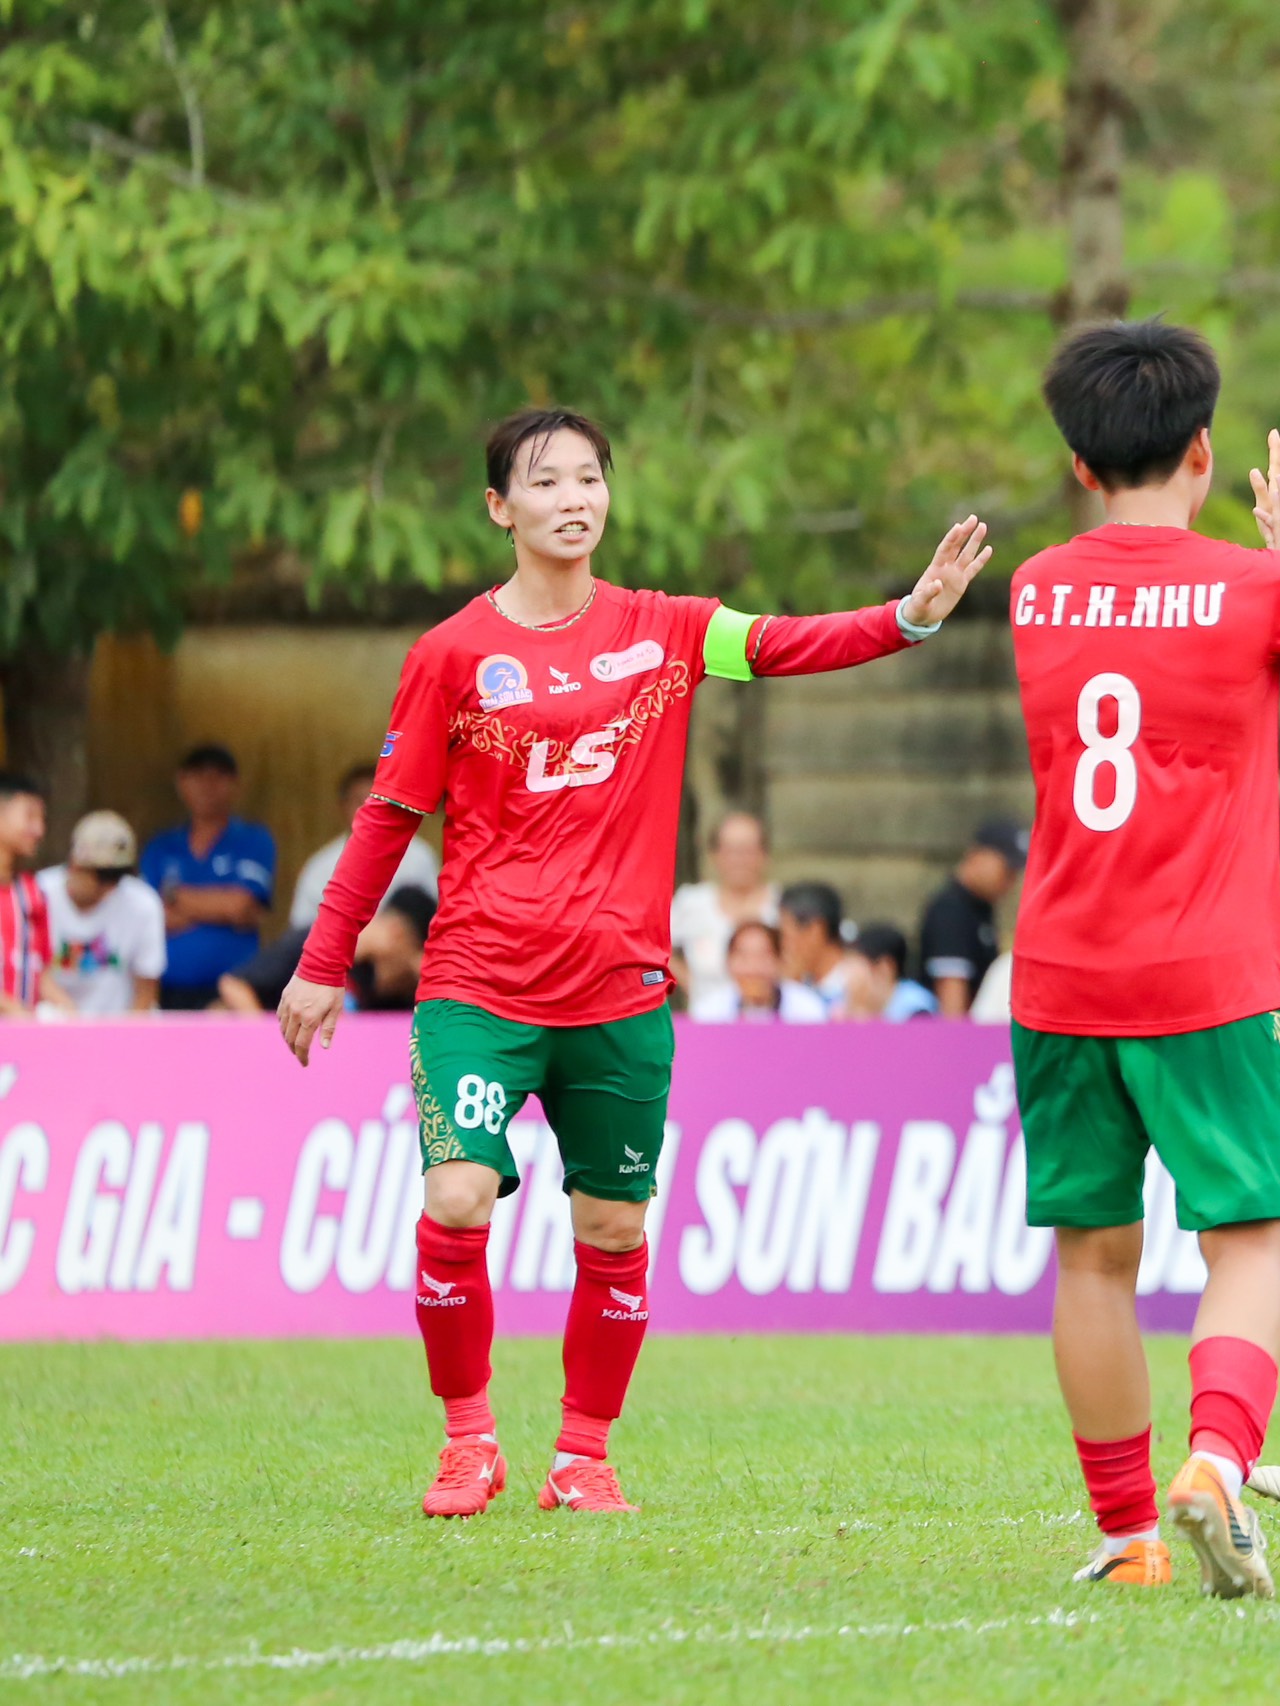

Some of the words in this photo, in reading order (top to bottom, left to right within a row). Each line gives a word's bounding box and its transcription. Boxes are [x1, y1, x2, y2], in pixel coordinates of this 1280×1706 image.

[548, 682, 582, 695] KAMITO
[525, 730, 616, 793] LS
[1072, 672, 1142, 832] 8
[454, 1073, 507, 1135] 88
[618, 1162, 650, 1174] KAMITO
[55, 1117, 212, 1296] GIA
[679, 1105, 882, 1296] SƠN
[416, 1294, 466, 1307] KAMITO
[601, 1308, 649, 1322] KAMITO
